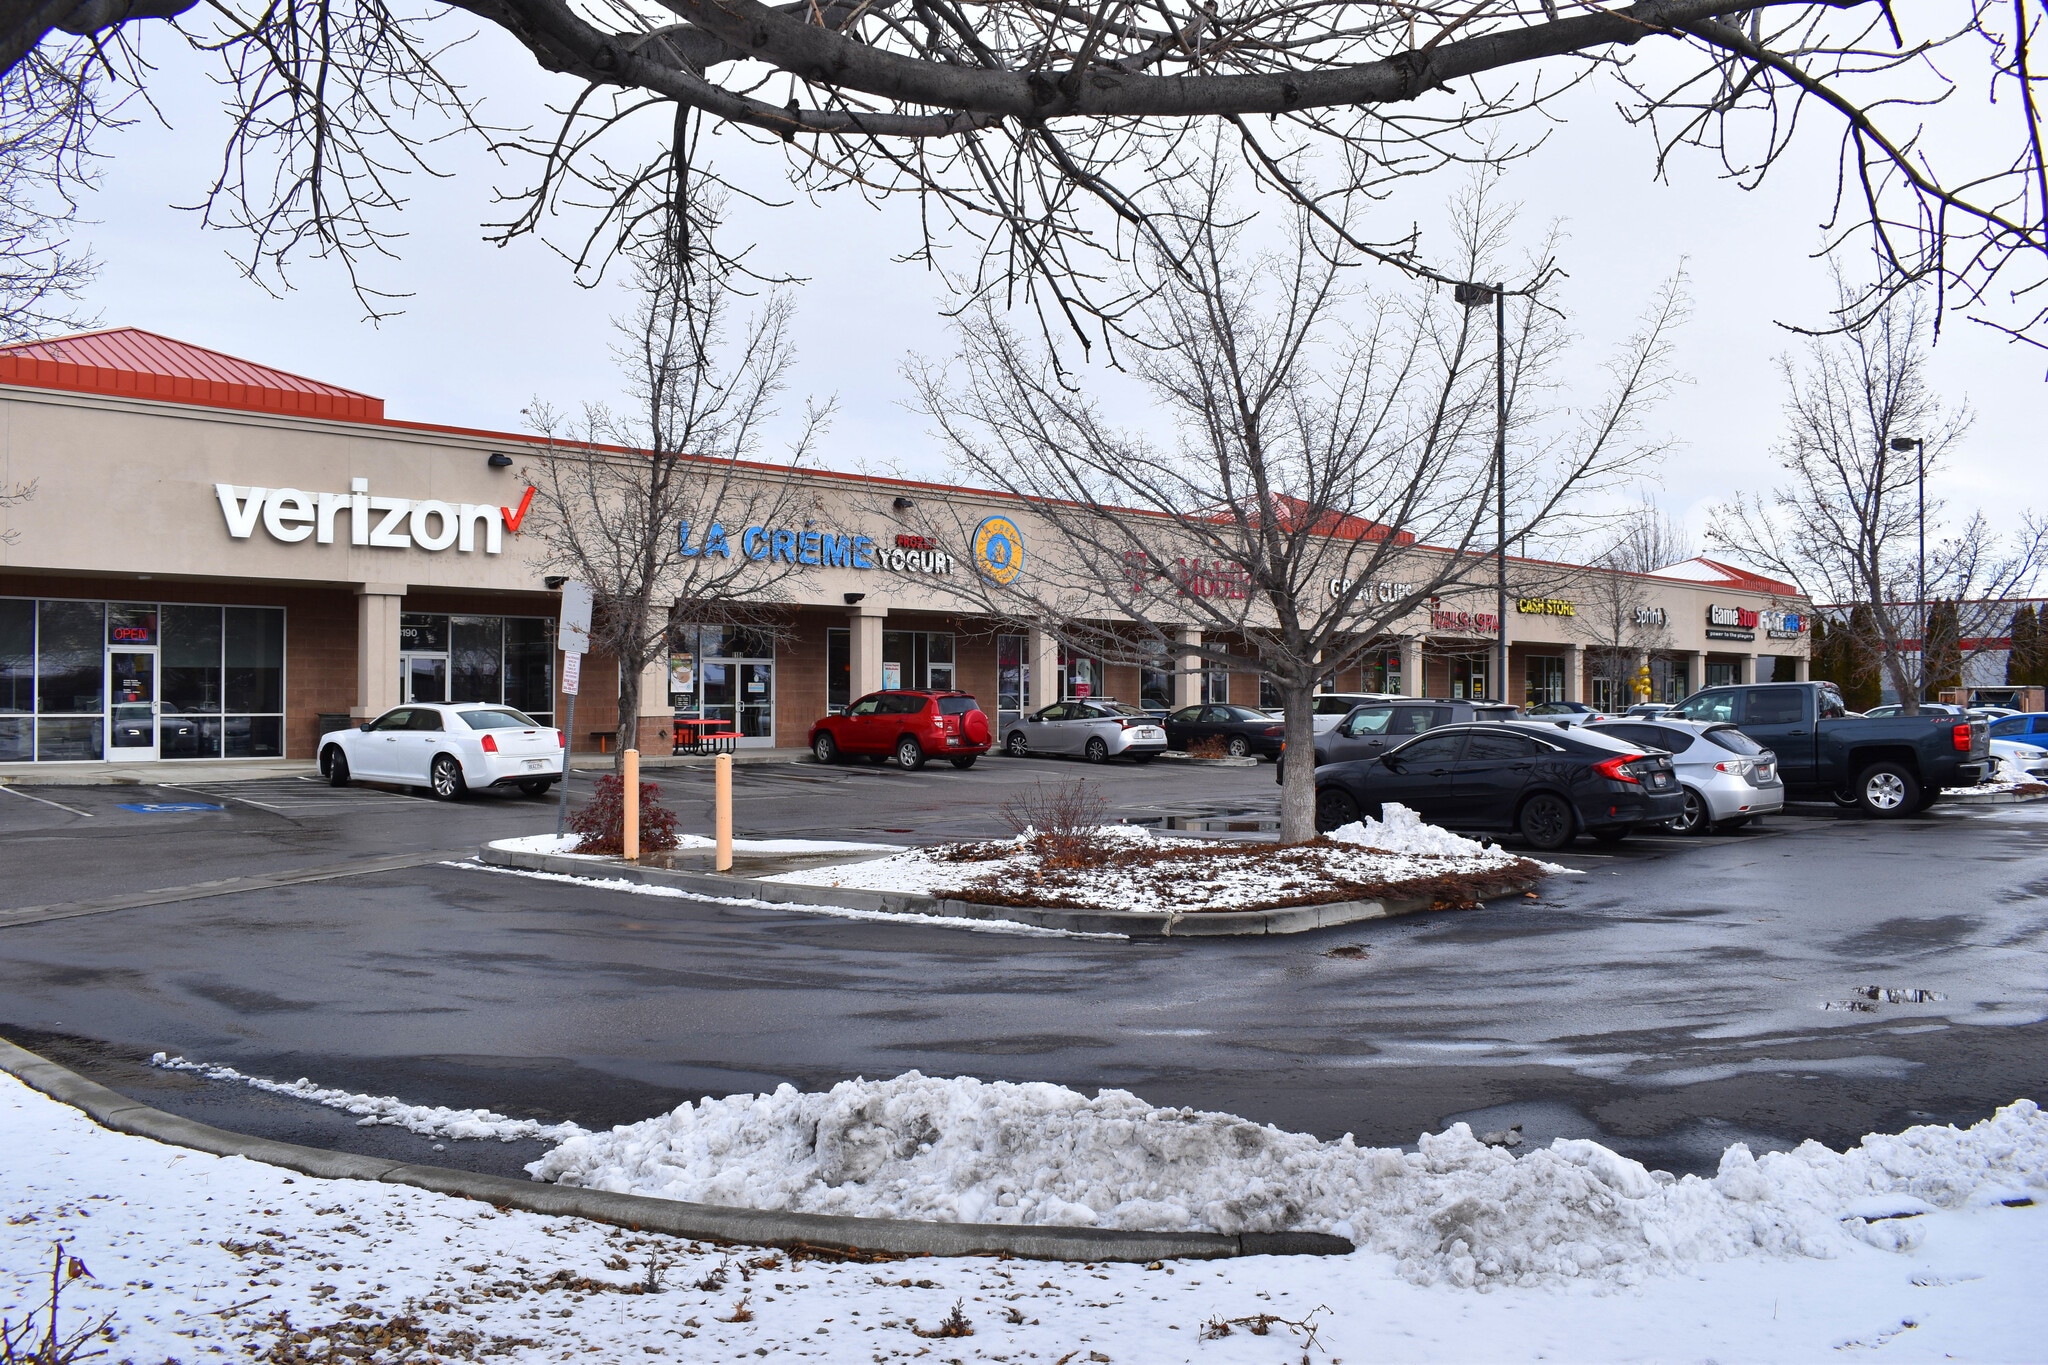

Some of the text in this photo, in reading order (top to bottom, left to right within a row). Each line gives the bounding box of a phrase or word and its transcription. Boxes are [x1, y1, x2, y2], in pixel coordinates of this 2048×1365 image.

[214, 477, 502, 554] verizon
[678, 518, 732, 558] LA
[878, 547, 955, 575] YOGURT
[1519, 597, 1576, 617] CASH STORE
[1636, 606, 1662, 628] Sprint
[1711, 604, 1758, 628] GameStop
[114, 628, 148, 640] OPEN
[400, 628, 418, 637] 190
[1477, 612, 1499, 634] SPA
